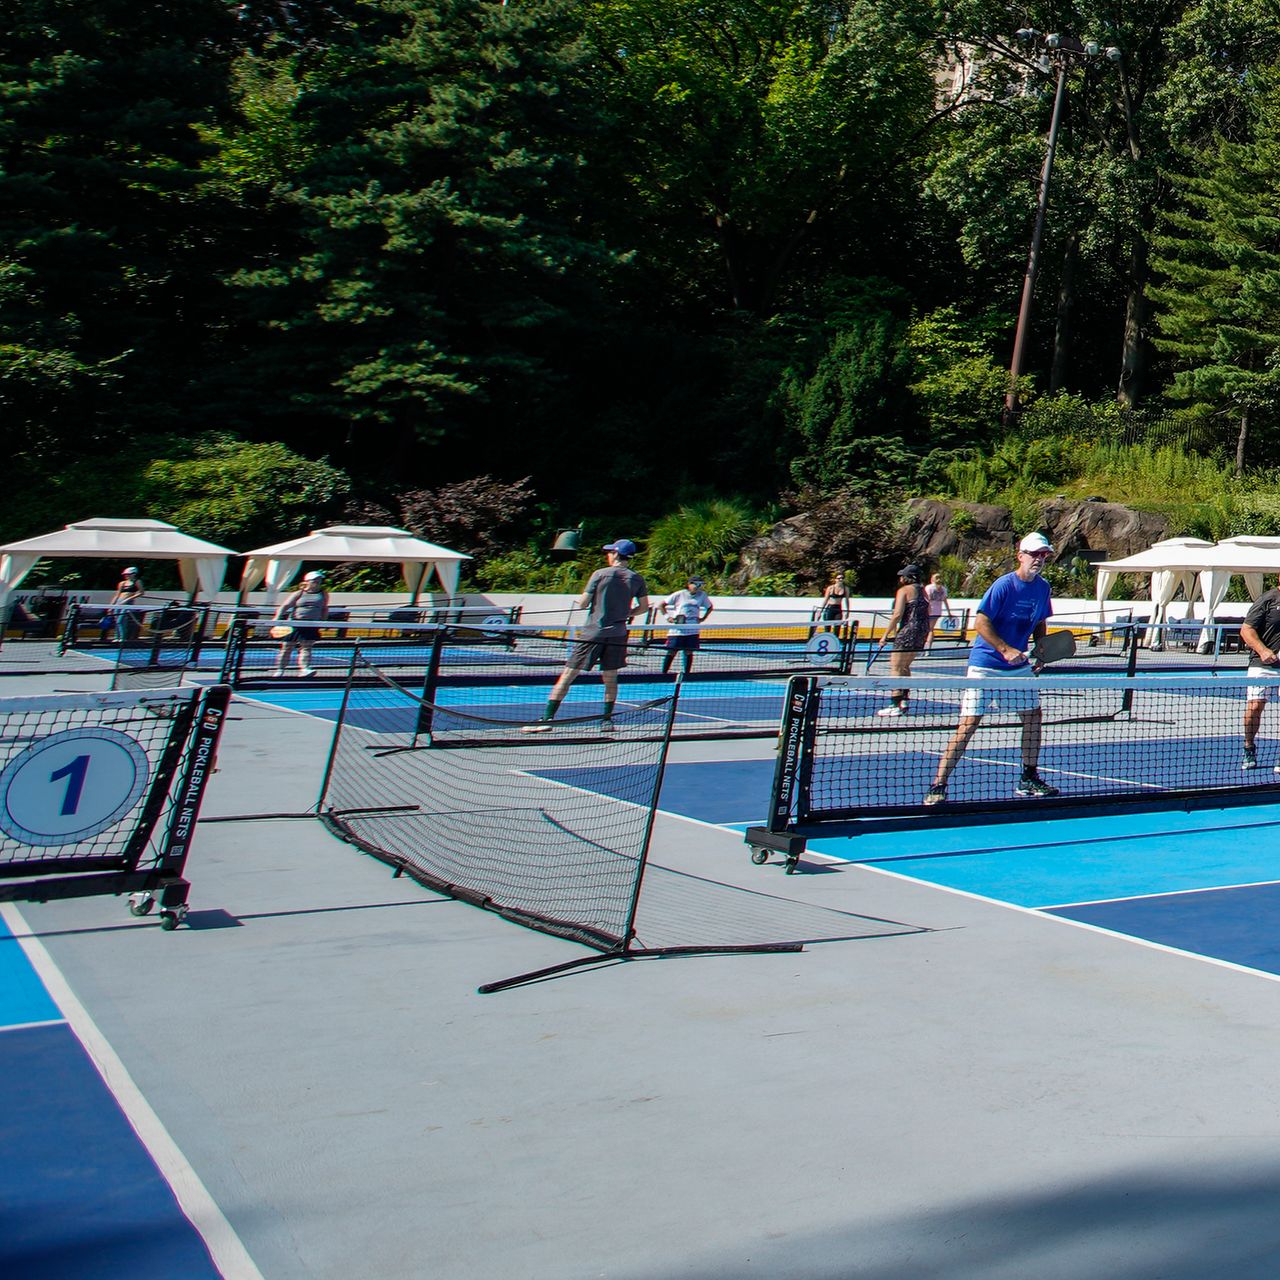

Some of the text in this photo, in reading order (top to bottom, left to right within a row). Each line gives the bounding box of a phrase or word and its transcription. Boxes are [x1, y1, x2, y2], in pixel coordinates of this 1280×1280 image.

[944, 619, 957, 629] 14
[817, 639, 829, 656] 8
[784, 717, 800, 773] PICKLEBALL
[50, 755, 91, 816] 1
[184, 737, 212, 808] PICKLEBALL
[780, 775, 791, 800] NETS
[176, 808, 192, 839] NETS
